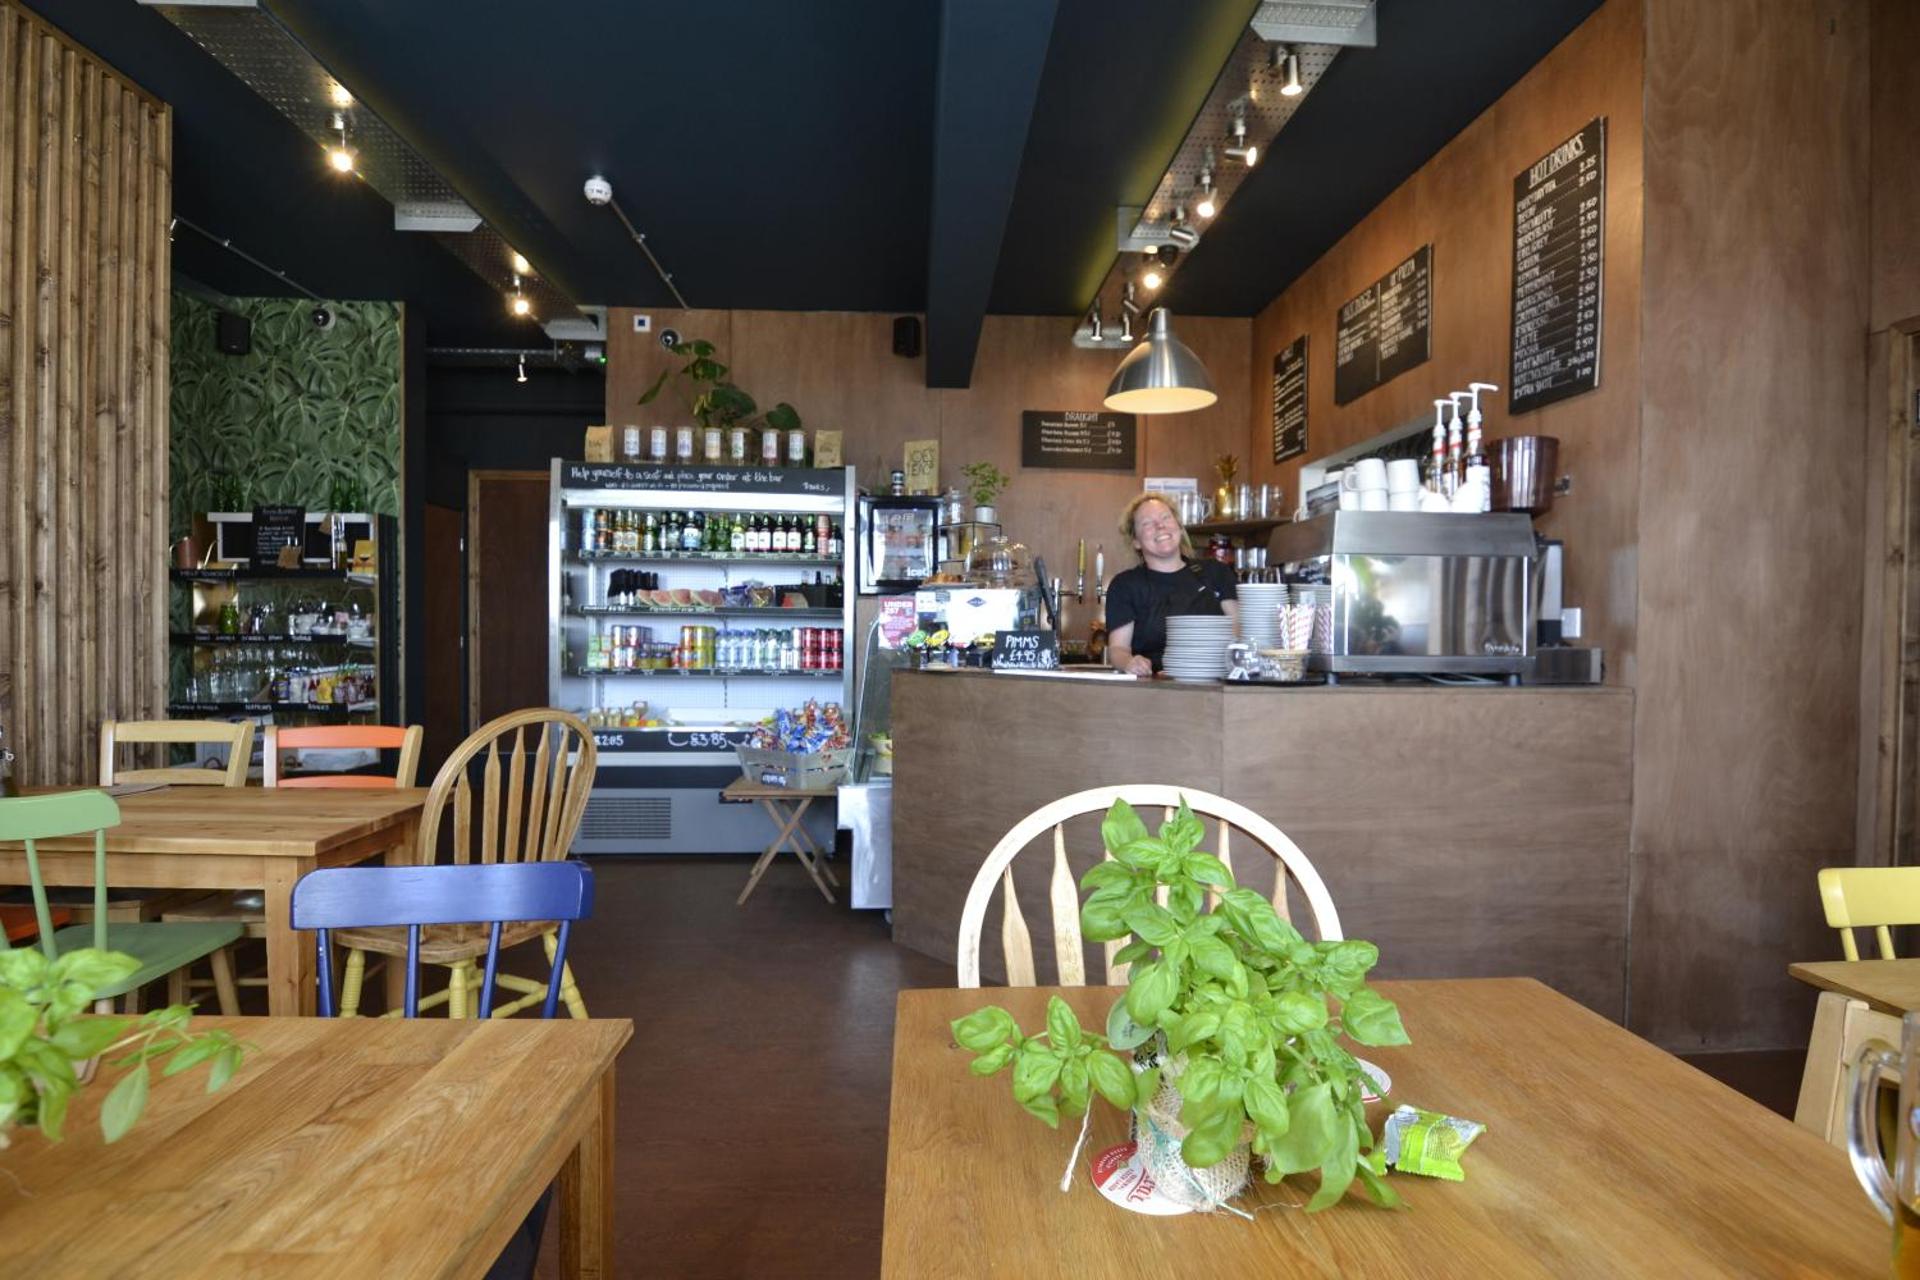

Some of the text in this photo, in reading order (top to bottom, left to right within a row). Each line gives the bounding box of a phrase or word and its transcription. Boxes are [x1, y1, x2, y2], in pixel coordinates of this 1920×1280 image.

[1515, 330, 1538, 350] LATTE
[571, 467, 590, 480] Help
[592, 467, 622, 481] yourself
[1005, 635, 1040, 649] PIMMS
